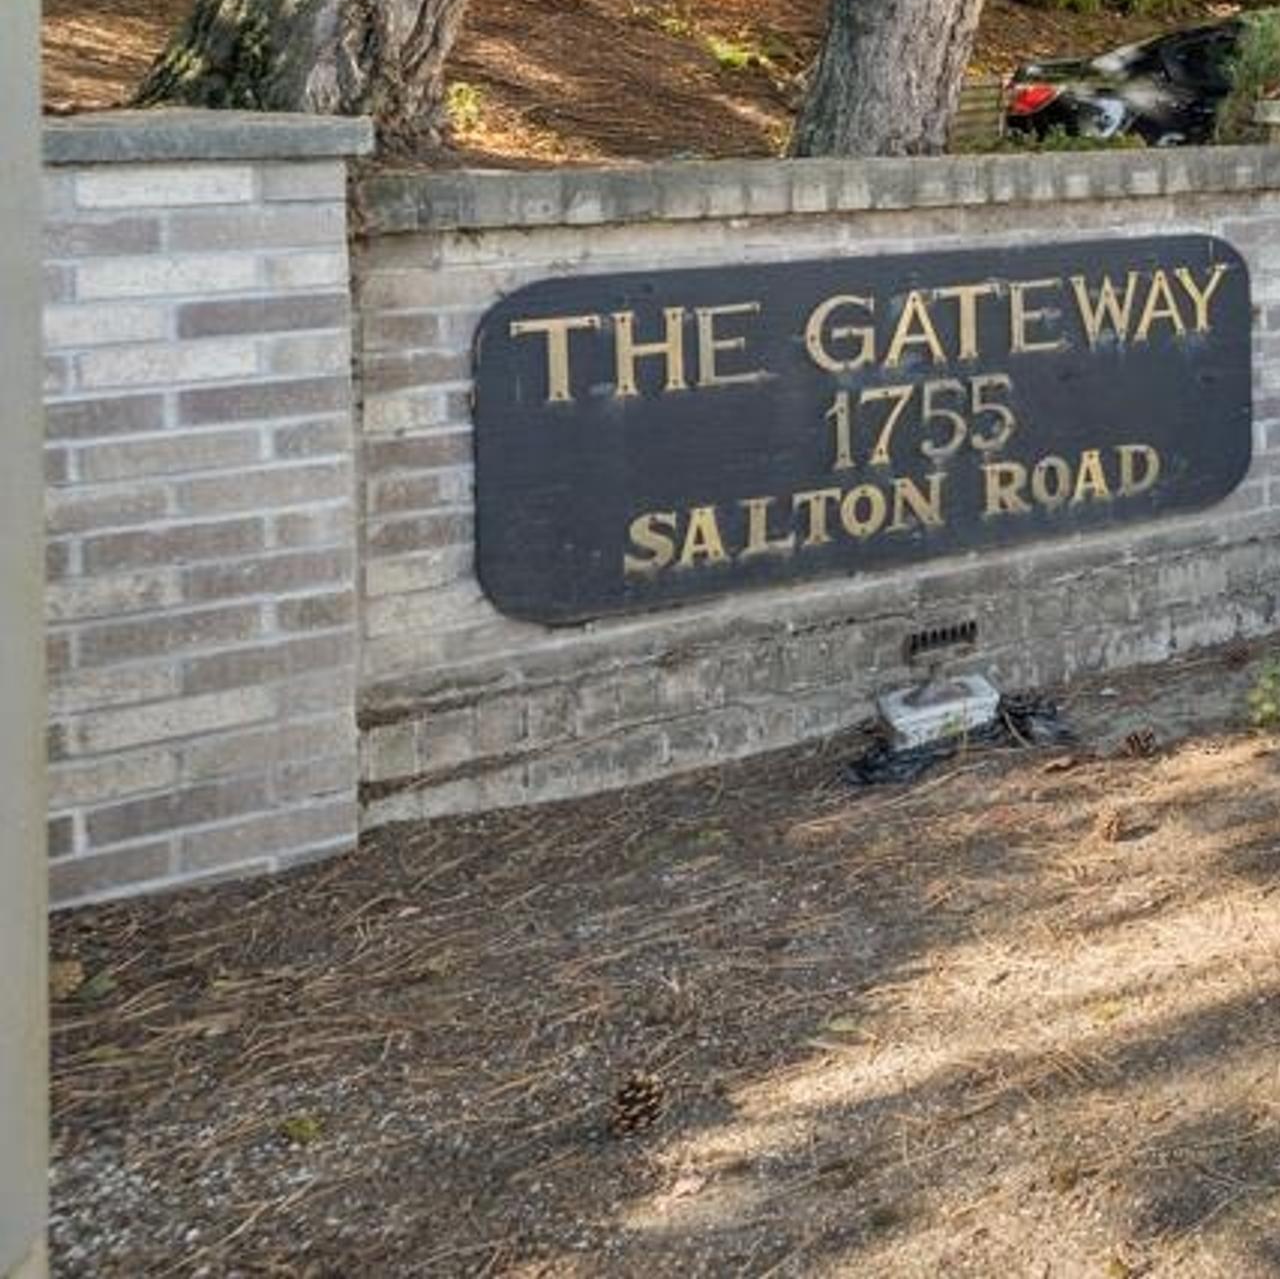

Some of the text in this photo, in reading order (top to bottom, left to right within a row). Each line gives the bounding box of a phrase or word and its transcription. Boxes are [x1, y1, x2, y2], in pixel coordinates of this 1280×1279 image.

[511, 263, 1229, 403] THE GATEWAY
[825, 374, 1016, 471] 1755
[623, 443, 1161, 577] SALTON ROAD
